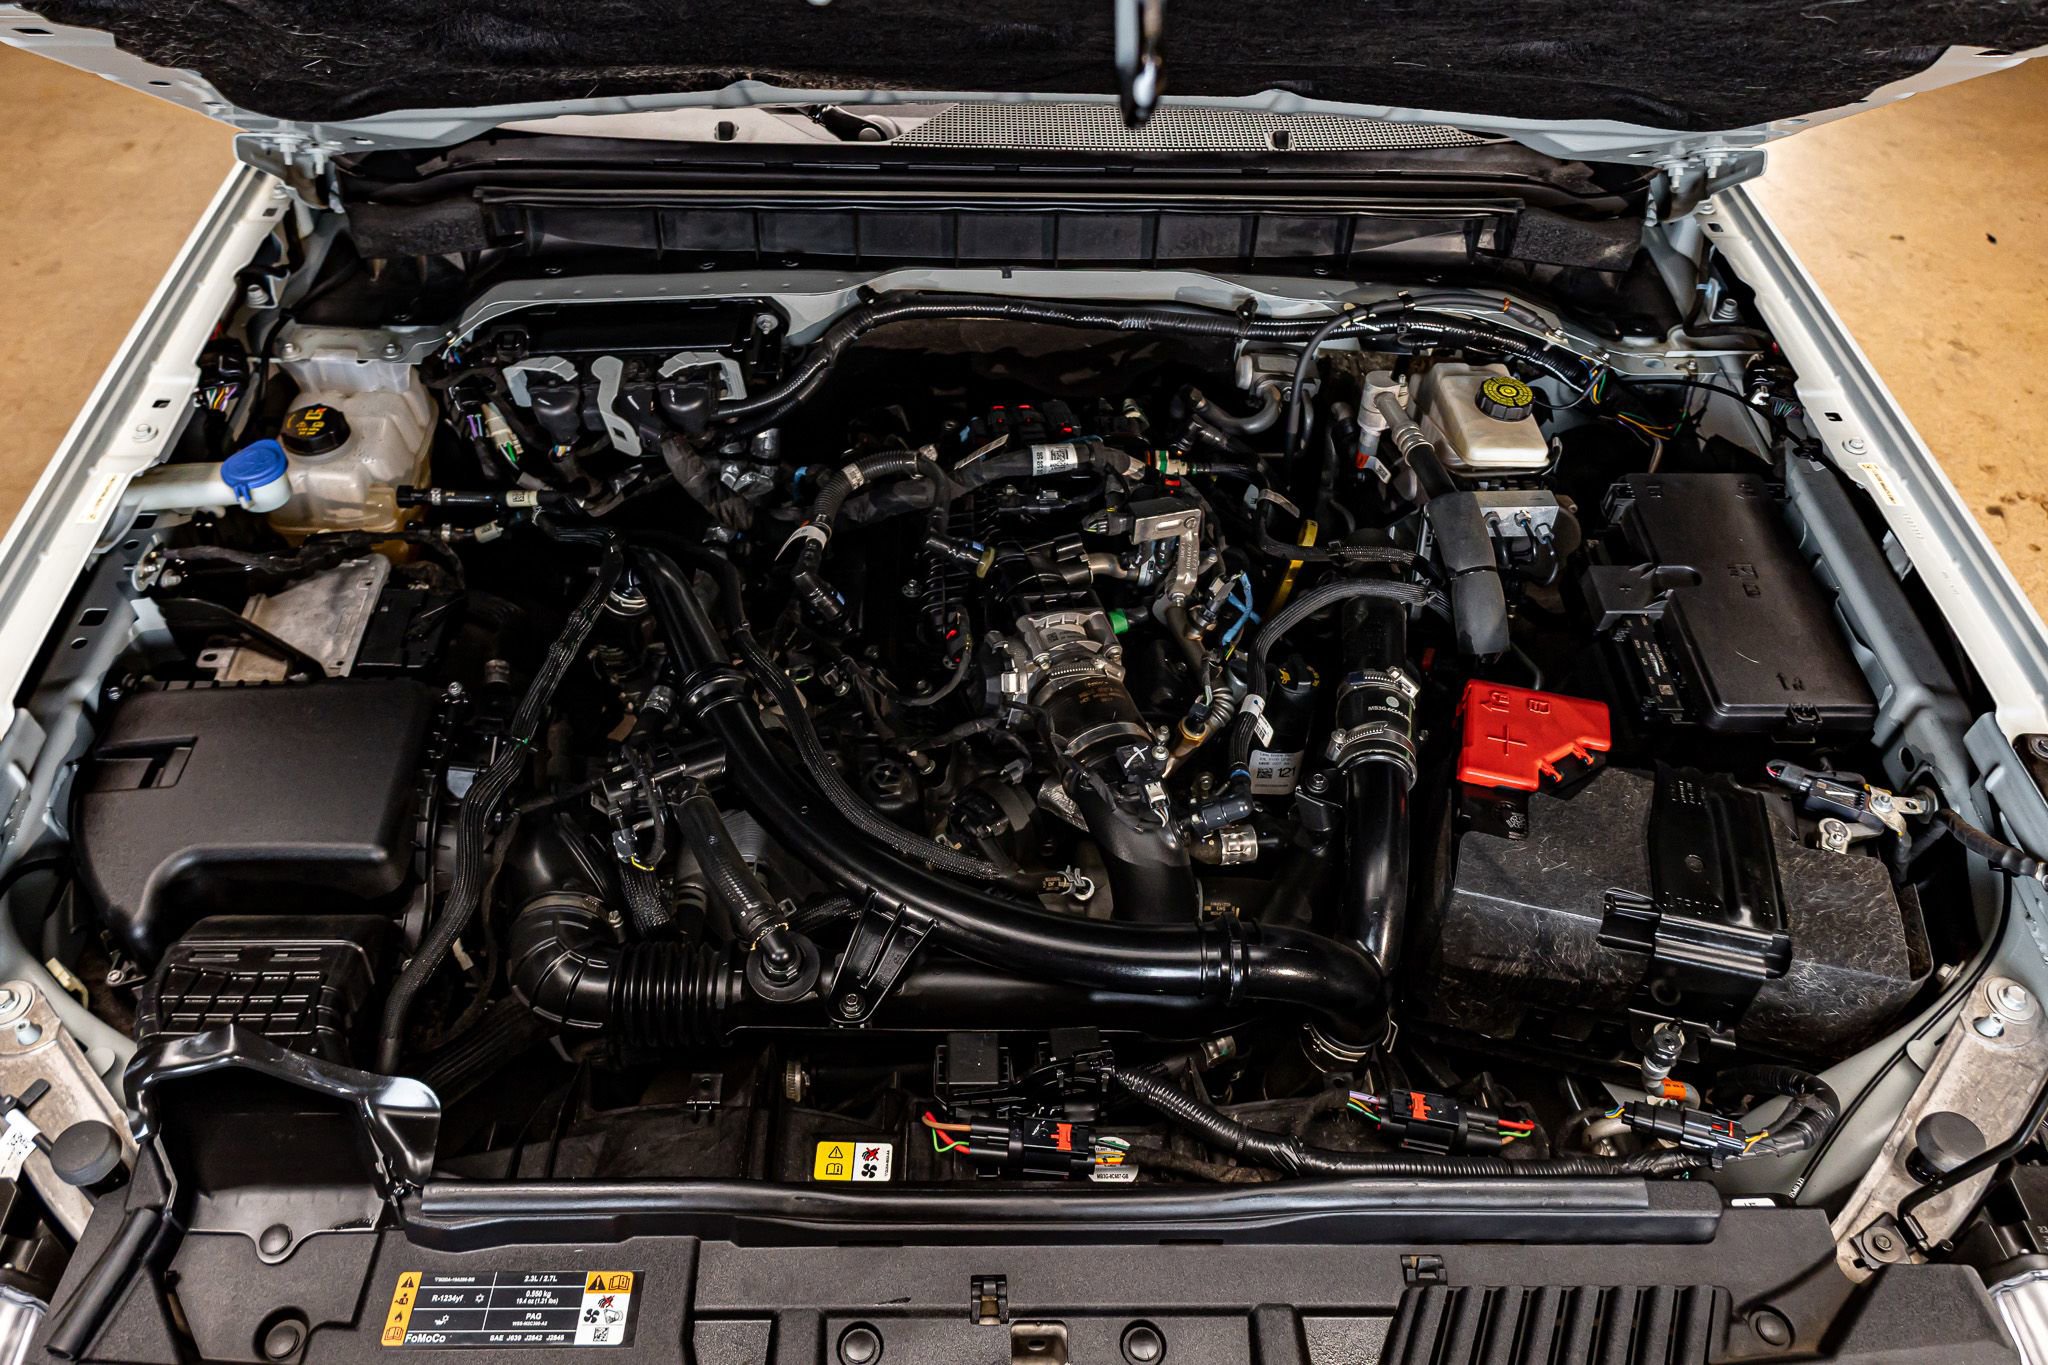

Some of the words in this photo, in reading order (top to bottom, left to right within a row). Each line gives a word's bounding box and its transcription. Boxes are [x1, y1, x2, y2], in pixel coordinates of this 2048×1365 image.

[1278, 768, 1296, 777] 121
[524, 1275, 538, 1283] 2.3L
[543, 1275, 558, 1283] 2.7L
[431, 1294, 464, 1304] R-1234yf
[543, 1290, 552, 1299] kg
[525, 1312, 542, 1321] PAG
[404, 1333, 447, 1344] FoMoCo
[489, 1334, 504, 1342] SAE
[506, 1334, 522, 1342] J639
